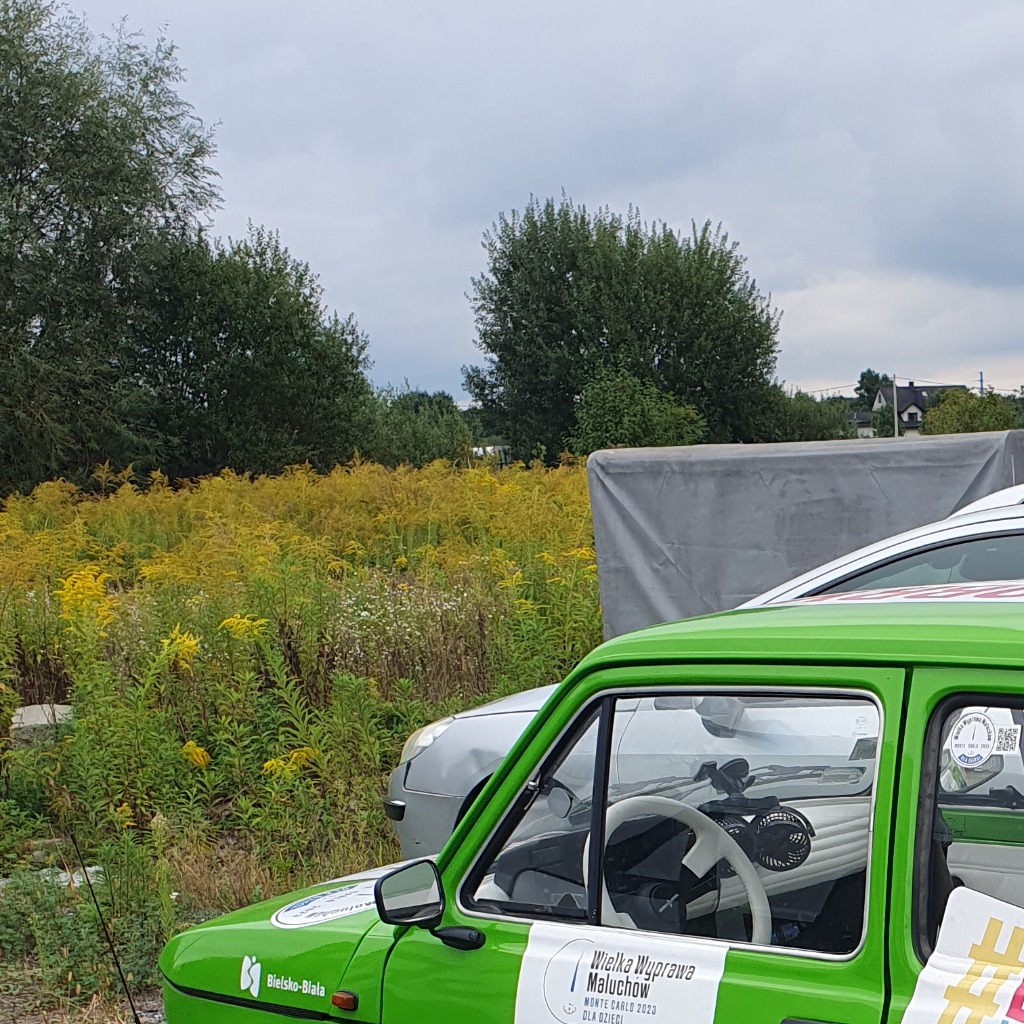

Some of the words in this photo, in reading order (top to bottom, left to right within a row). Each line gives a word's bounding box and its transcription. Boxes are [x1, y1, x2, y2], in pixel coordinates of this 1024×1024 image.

[591, 950, 633, 974] Wielka
[634, 955, 695, 982] Wyprawa
[587, 972, 650, 999] Maluchów
[582, 1010, 596, 1022] DLA
[584, 997, 609, 1009] MONTE
[611, 999, 634, 1013] CARLO
[637, 1003, 657, 1016] 2023
